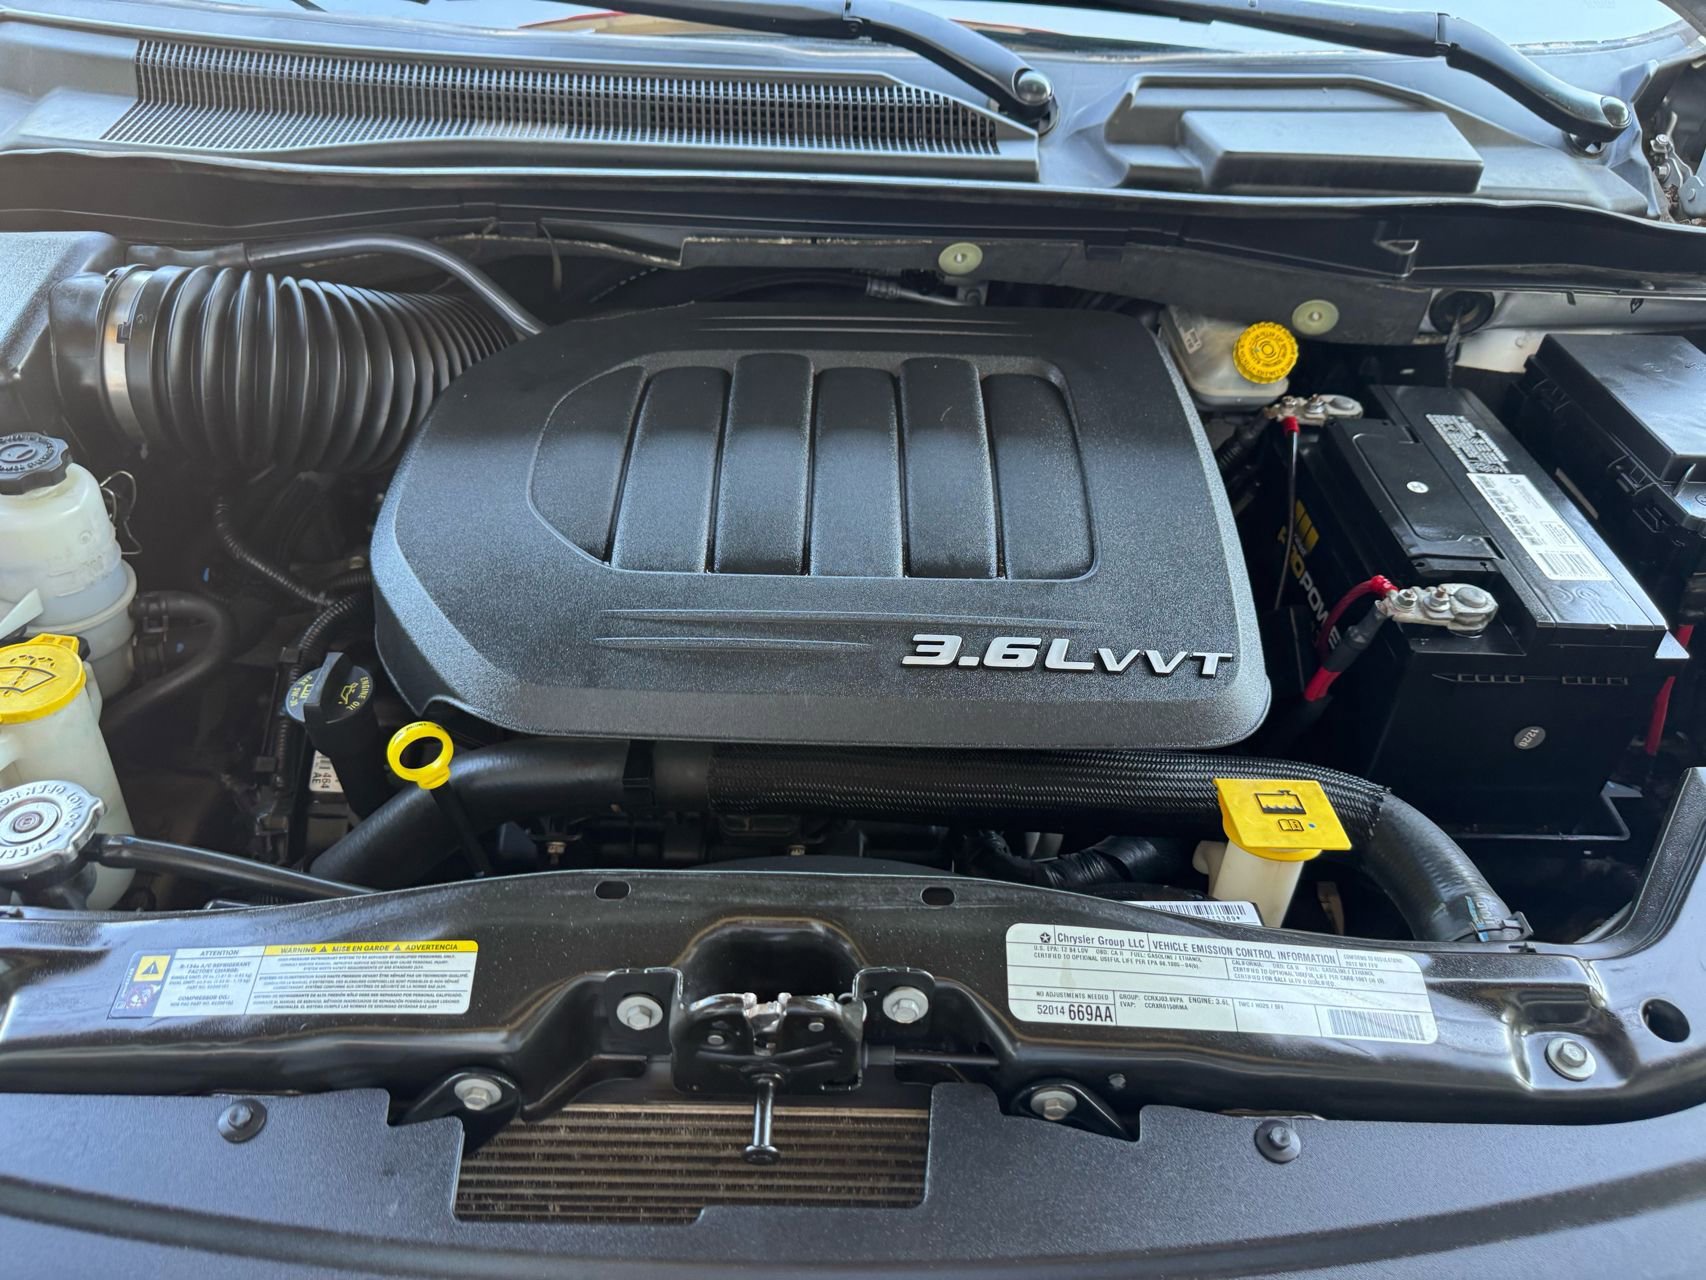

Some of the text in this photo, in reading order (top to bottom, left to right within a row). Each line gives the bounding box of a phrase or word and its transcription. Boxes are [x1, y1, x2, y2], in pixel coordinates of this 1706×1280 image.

[345, 676, 370, 711] ENGINE OIL
[1518, 729, 1539, 747] 12/20
[331, 945, 350, 953] MISE
[363, 944, 390, 952] GARDE
[405, 943, 458, 951] ADVERTENCIA
[1057, 932, 1145, 949] Chrysler Group LLC
[1152, 940, 1336, 964] VEHICLE EMISSION CONTROL INFORMATION
[1045, 991, 1086, 999] ADJUSTMENTS
[1036, 1003, 1114, 1023] 52014 669AA
